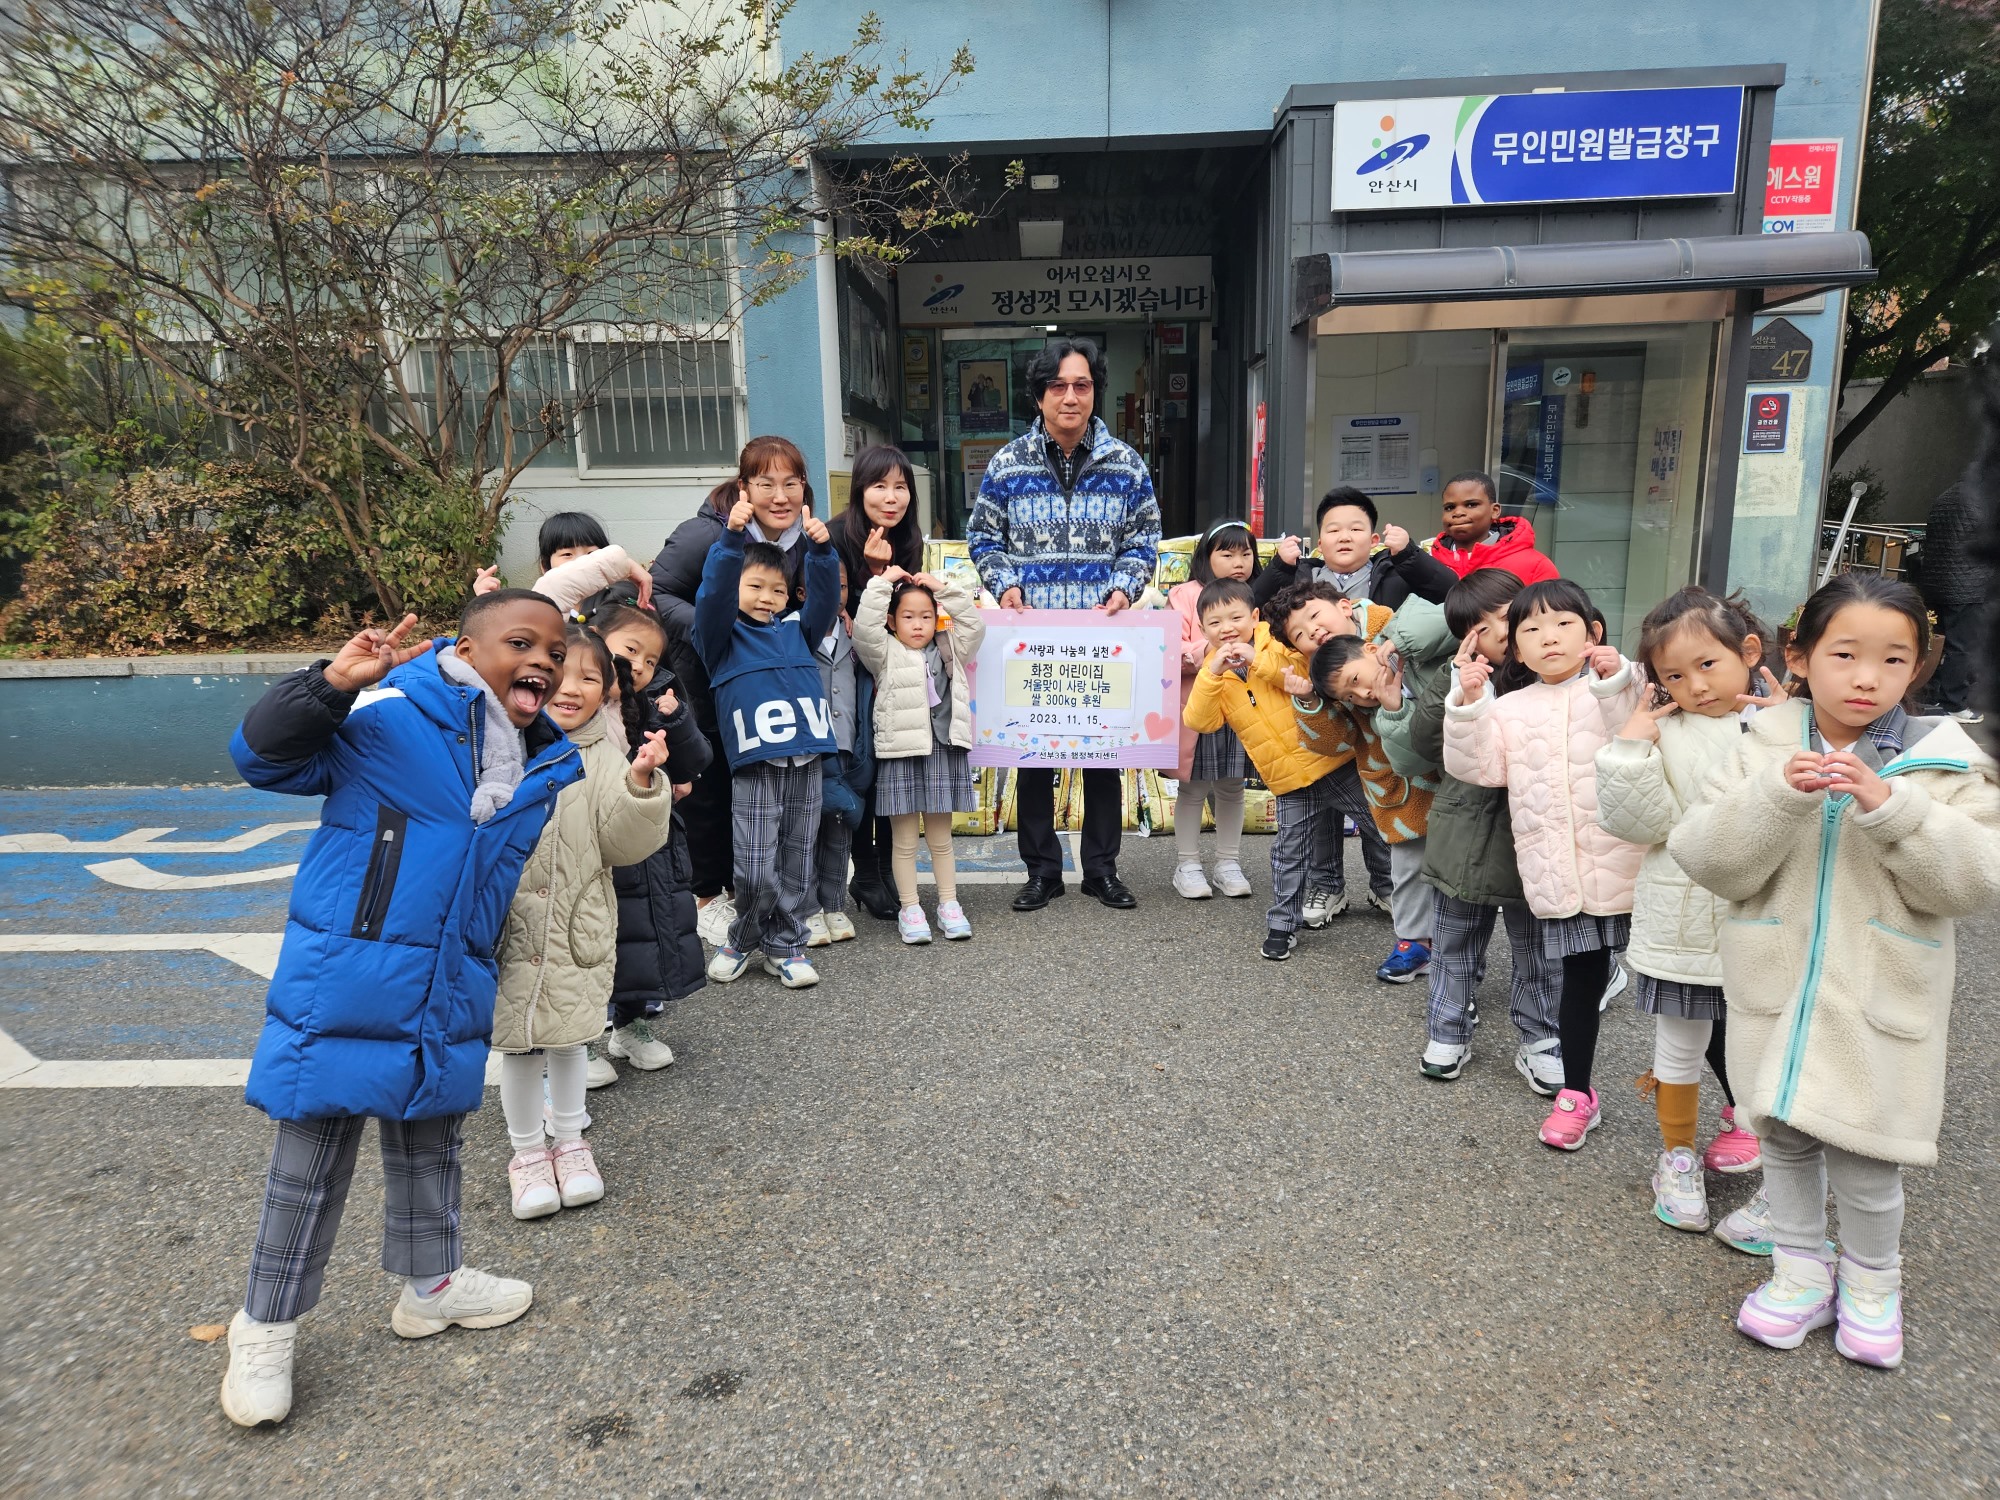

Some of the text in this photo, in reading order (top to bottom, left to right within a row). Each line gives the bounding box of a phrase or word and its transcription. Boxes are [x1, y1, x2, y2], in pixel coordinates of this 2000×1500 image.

[1492, 124, 1721, 166] 무인민원발급창구
[1766, 165, 1822, 190] 에스원
[1368, 178, 1418, 194] 안산시
[1770, 194, 1812, 204] CCTV 작동중
[1046, 264, 1152, 284] 어서오십시오
[991, 285, 1208, 316] 정성껏 모시겠습니다
[929, 306, 958, 315] 안산시
[1771, 350, 1809, 377] 47
[1543, 404, 1558, 482] 무인민원발급창구
[1028, 645, 1110, 659] 사랑과 나눔의 실천
[1030, 663, 1104, 679] 화정 어린이집
[1022, 679, 1111, 694] 겨울맞이 사랑 나눔
[1031, 694, 1101, 708] 쌀 300kg 후원
[733, 697, 836, 753] Lev
[1030, 714, 1102, 726] 2023. 11. 15.
[1039, 750, 1119, 761] 선부3동 행정복지센터
